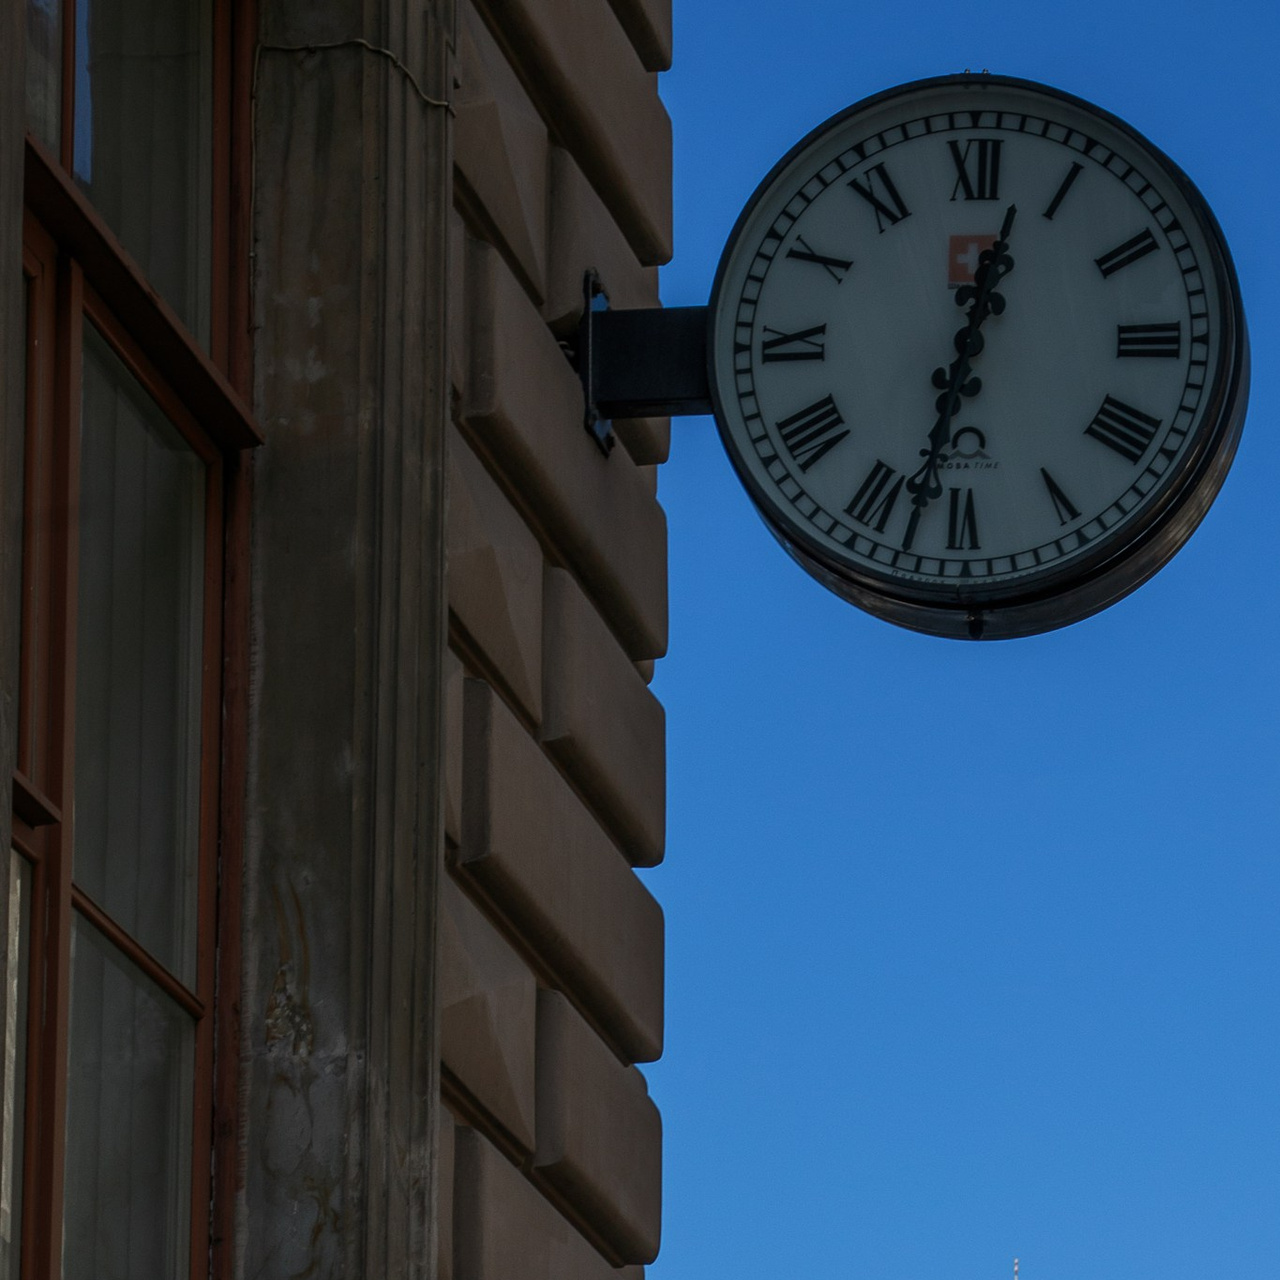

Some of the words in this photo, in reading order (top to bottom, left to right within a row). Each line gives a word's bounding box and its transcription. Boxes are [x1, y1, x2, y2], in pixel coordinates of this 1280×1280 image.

[845, 161, 912, 235] XI
[947, 138, 1005, 201] XII
[1041, 160, 1085, 221] I
[785, 233, 854, 285] X
[1093, 227, 1161, 279] II
[761, 322, 827, 365] IX
[1116, 320, 1181, 360] III
[775, 393, 852, 474] VIII
[843, 459, 907, 534] VII
[945, 487, 982, 551] VI
[1040, 466, 1083, 526] V
